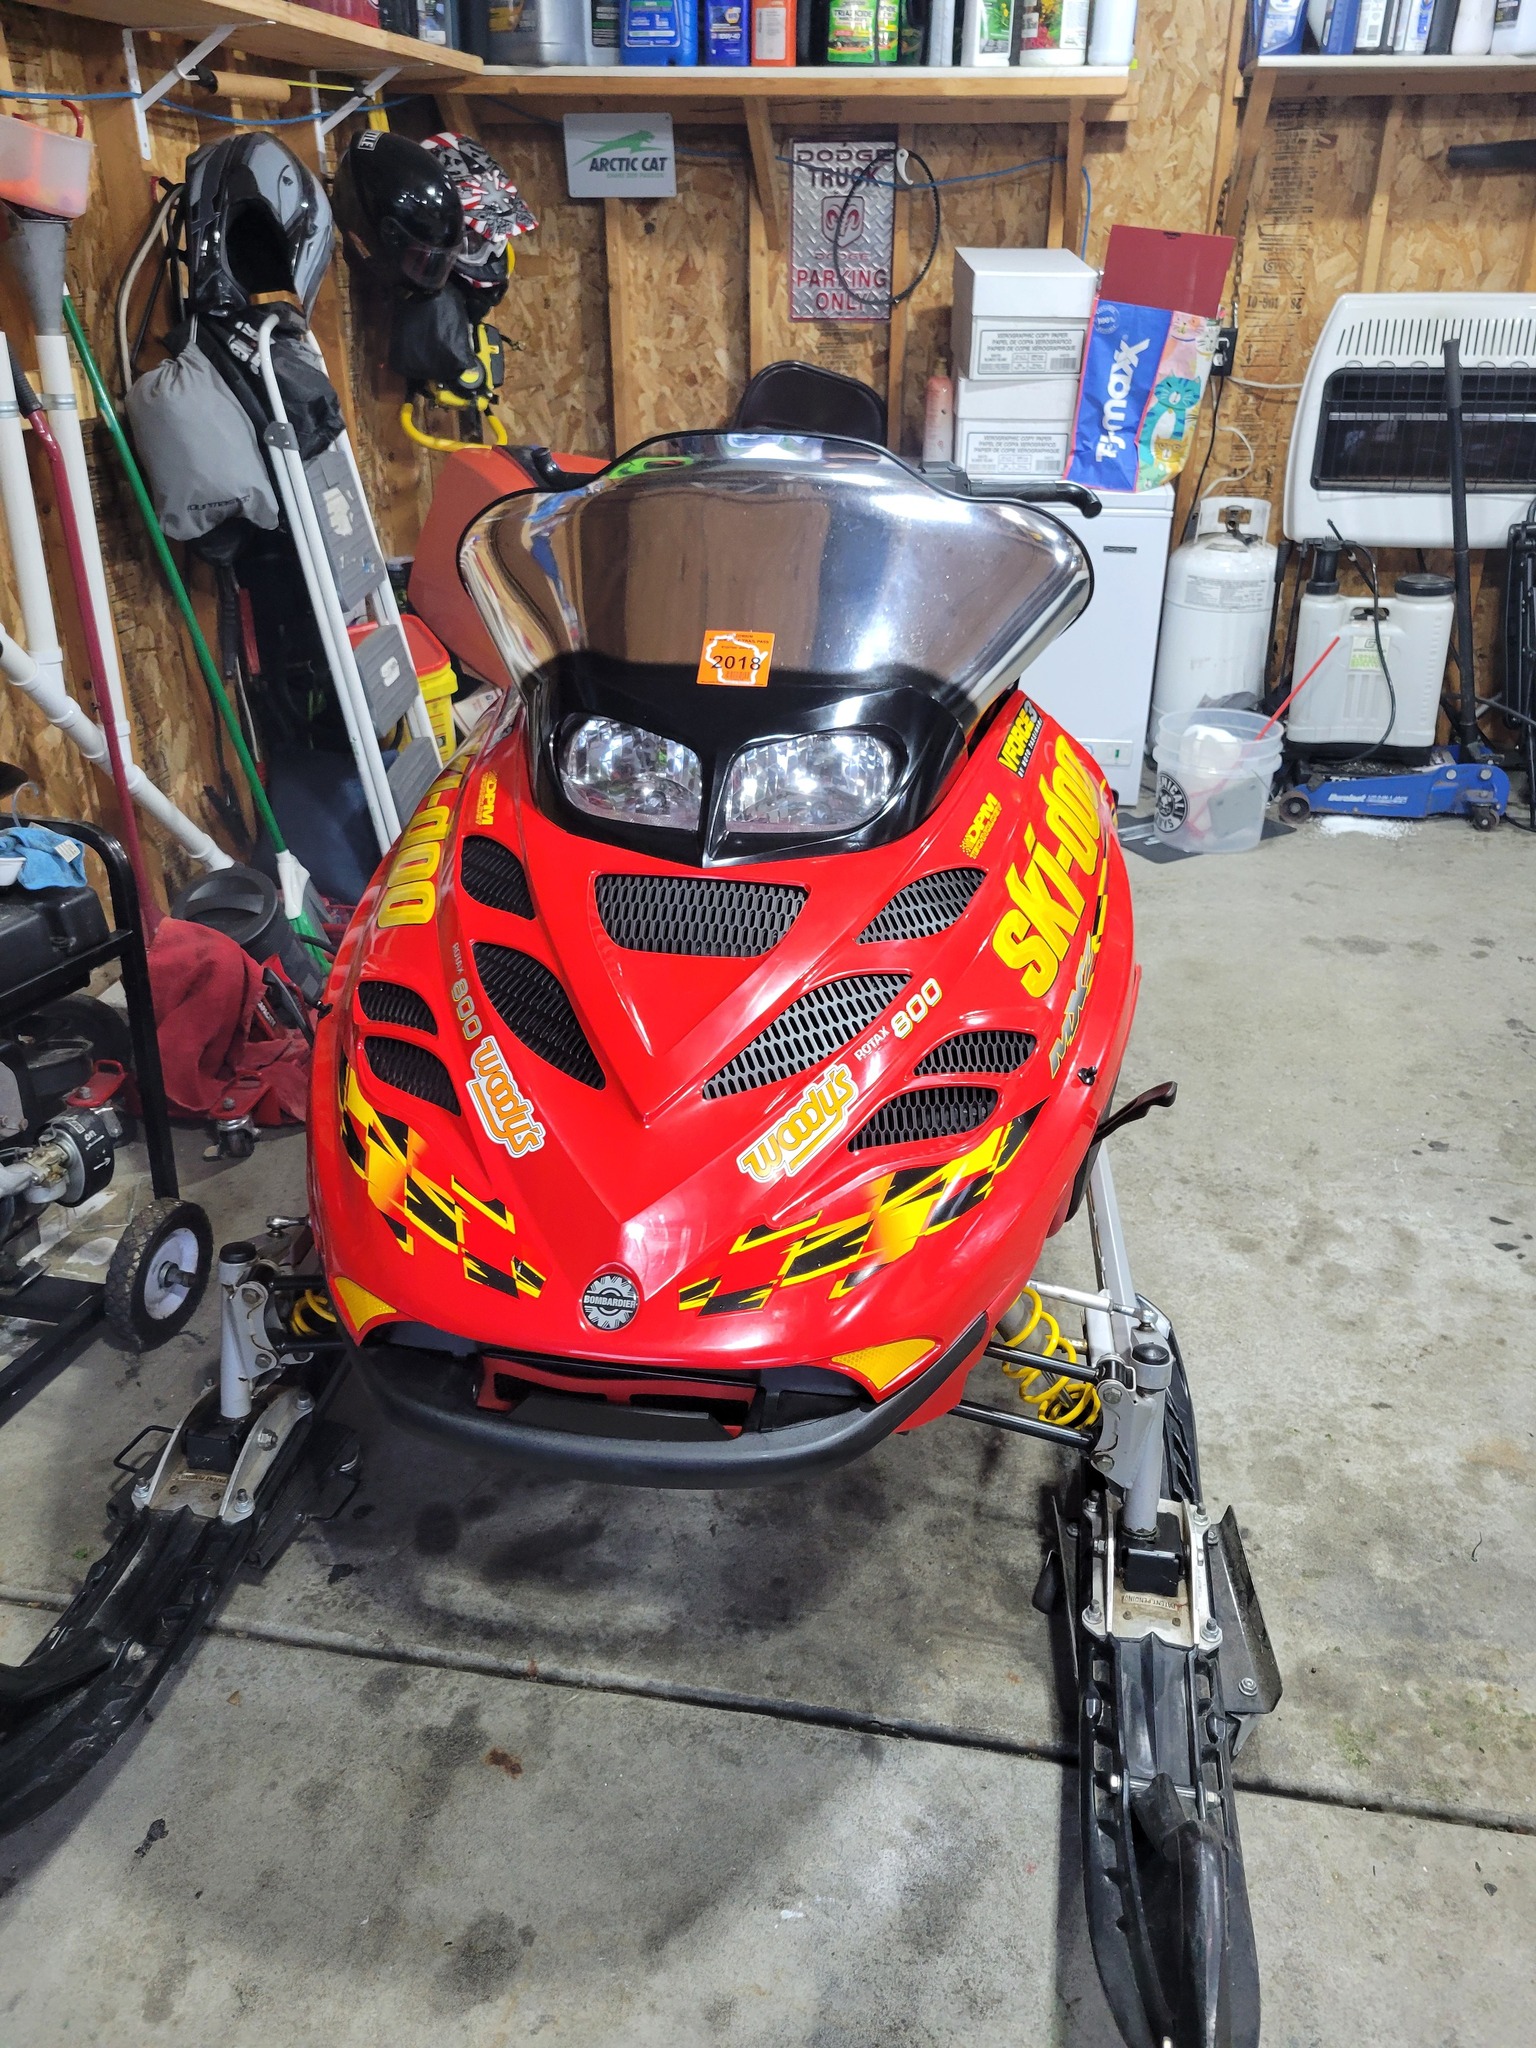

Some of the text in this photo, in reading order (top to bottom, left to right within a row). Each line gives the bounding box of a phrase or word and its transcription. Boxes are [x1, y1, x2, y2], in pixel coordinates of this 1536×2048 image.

[589, 157, 668, 171] ARCTIC CAT
[797, 150, 893, 162] DODGE
[797, 269, 888, 288] PARKING
[815, 292, 866, 311] ONLY
[711, 655, 761, 670] 2018
[482, 778, 497, 825] DPM
[966, 792, 998, 844] DPM
[451, 942, 483, 1040] ROTAX 800
[853, 977, 943, 1061] ROTAX 800
[583, 1295, 636, 1309] BOMBARDIER
